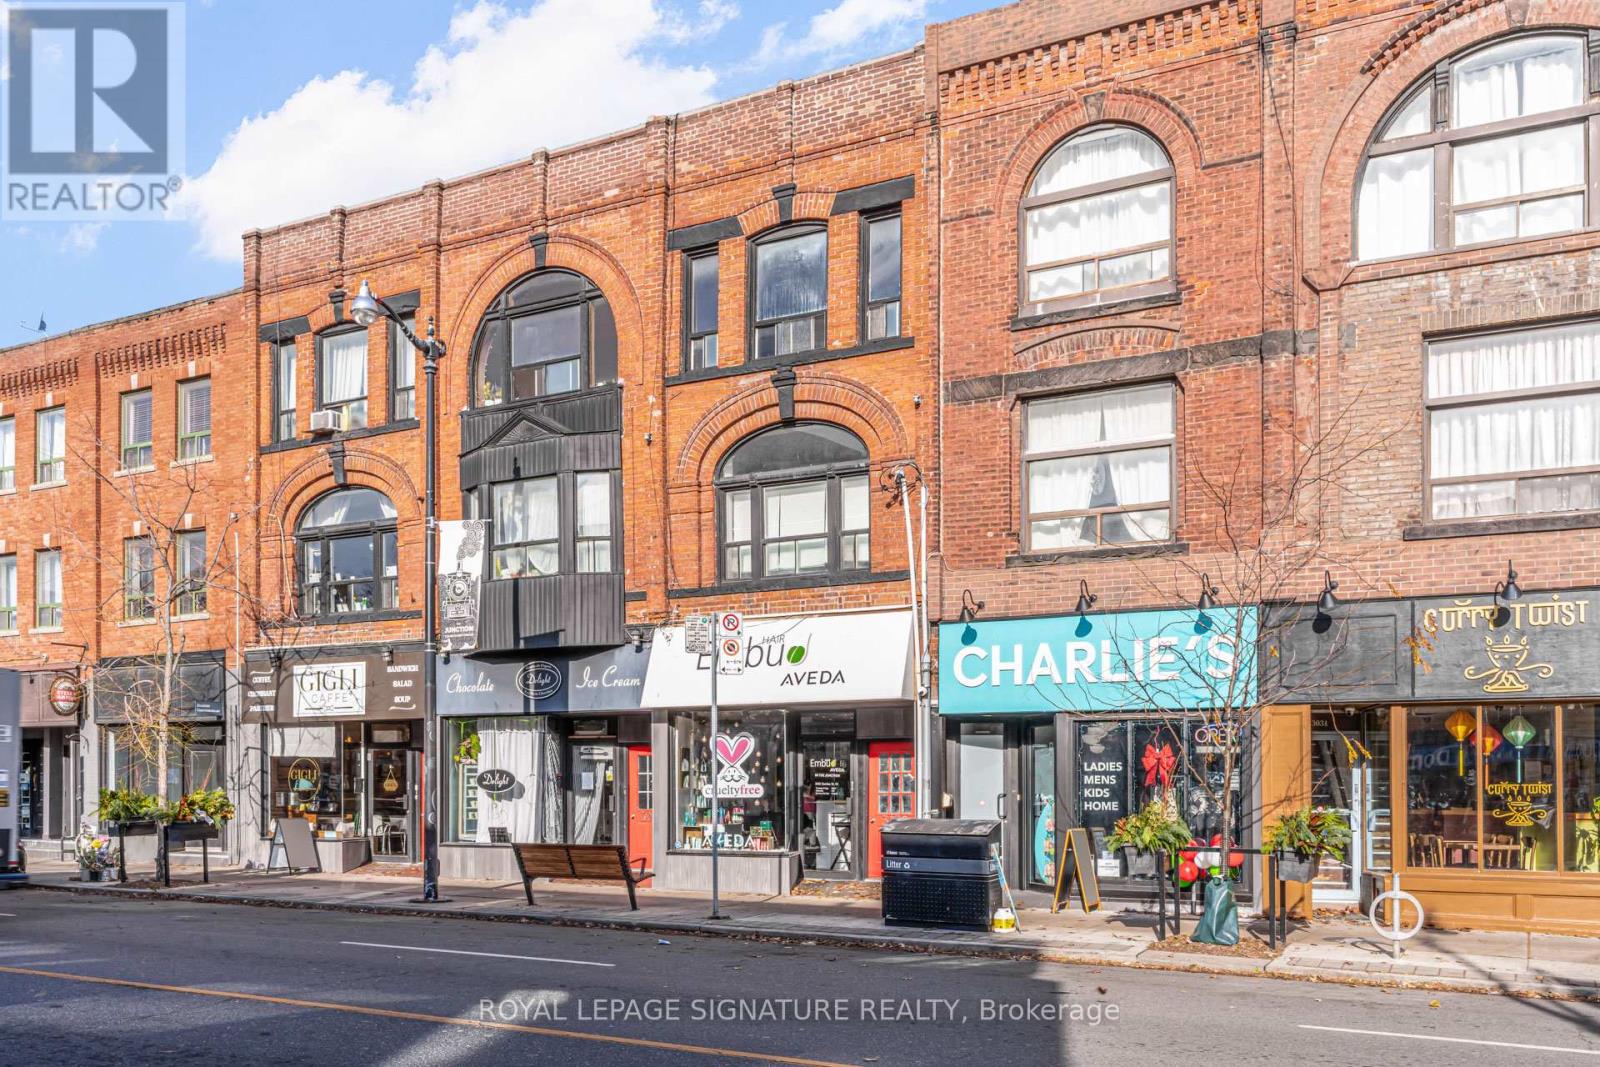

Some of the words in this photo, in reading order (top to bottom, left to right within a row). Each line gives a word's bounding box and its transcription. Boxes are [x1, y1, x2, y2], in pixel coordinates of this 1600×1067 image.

[762, 633, 786, 645] HAIR
[953, 635, 1237, 688] CHARLIE'S
[300, 668, 357, 692] GIGLI
[576, 666, 598, 688] Ice
[602, 665, 641, 687] Cream
[780, 669, 846, 686] AVEDA
[392, 679, 413, 687] SALAD
[446, 672, 495, 694] Chocolate
[394, 695, 411, 703] SOUP
[1084, 762, 1123, 772] LADIES
[482, 772, 510, 788] Delight
[1084, 775, 1116, 785] MENS
[1084, 788, 1110, 798] KIDS
[1084, 801, 1119, 811] HOME
[886, 859, 902, 869] Litter
